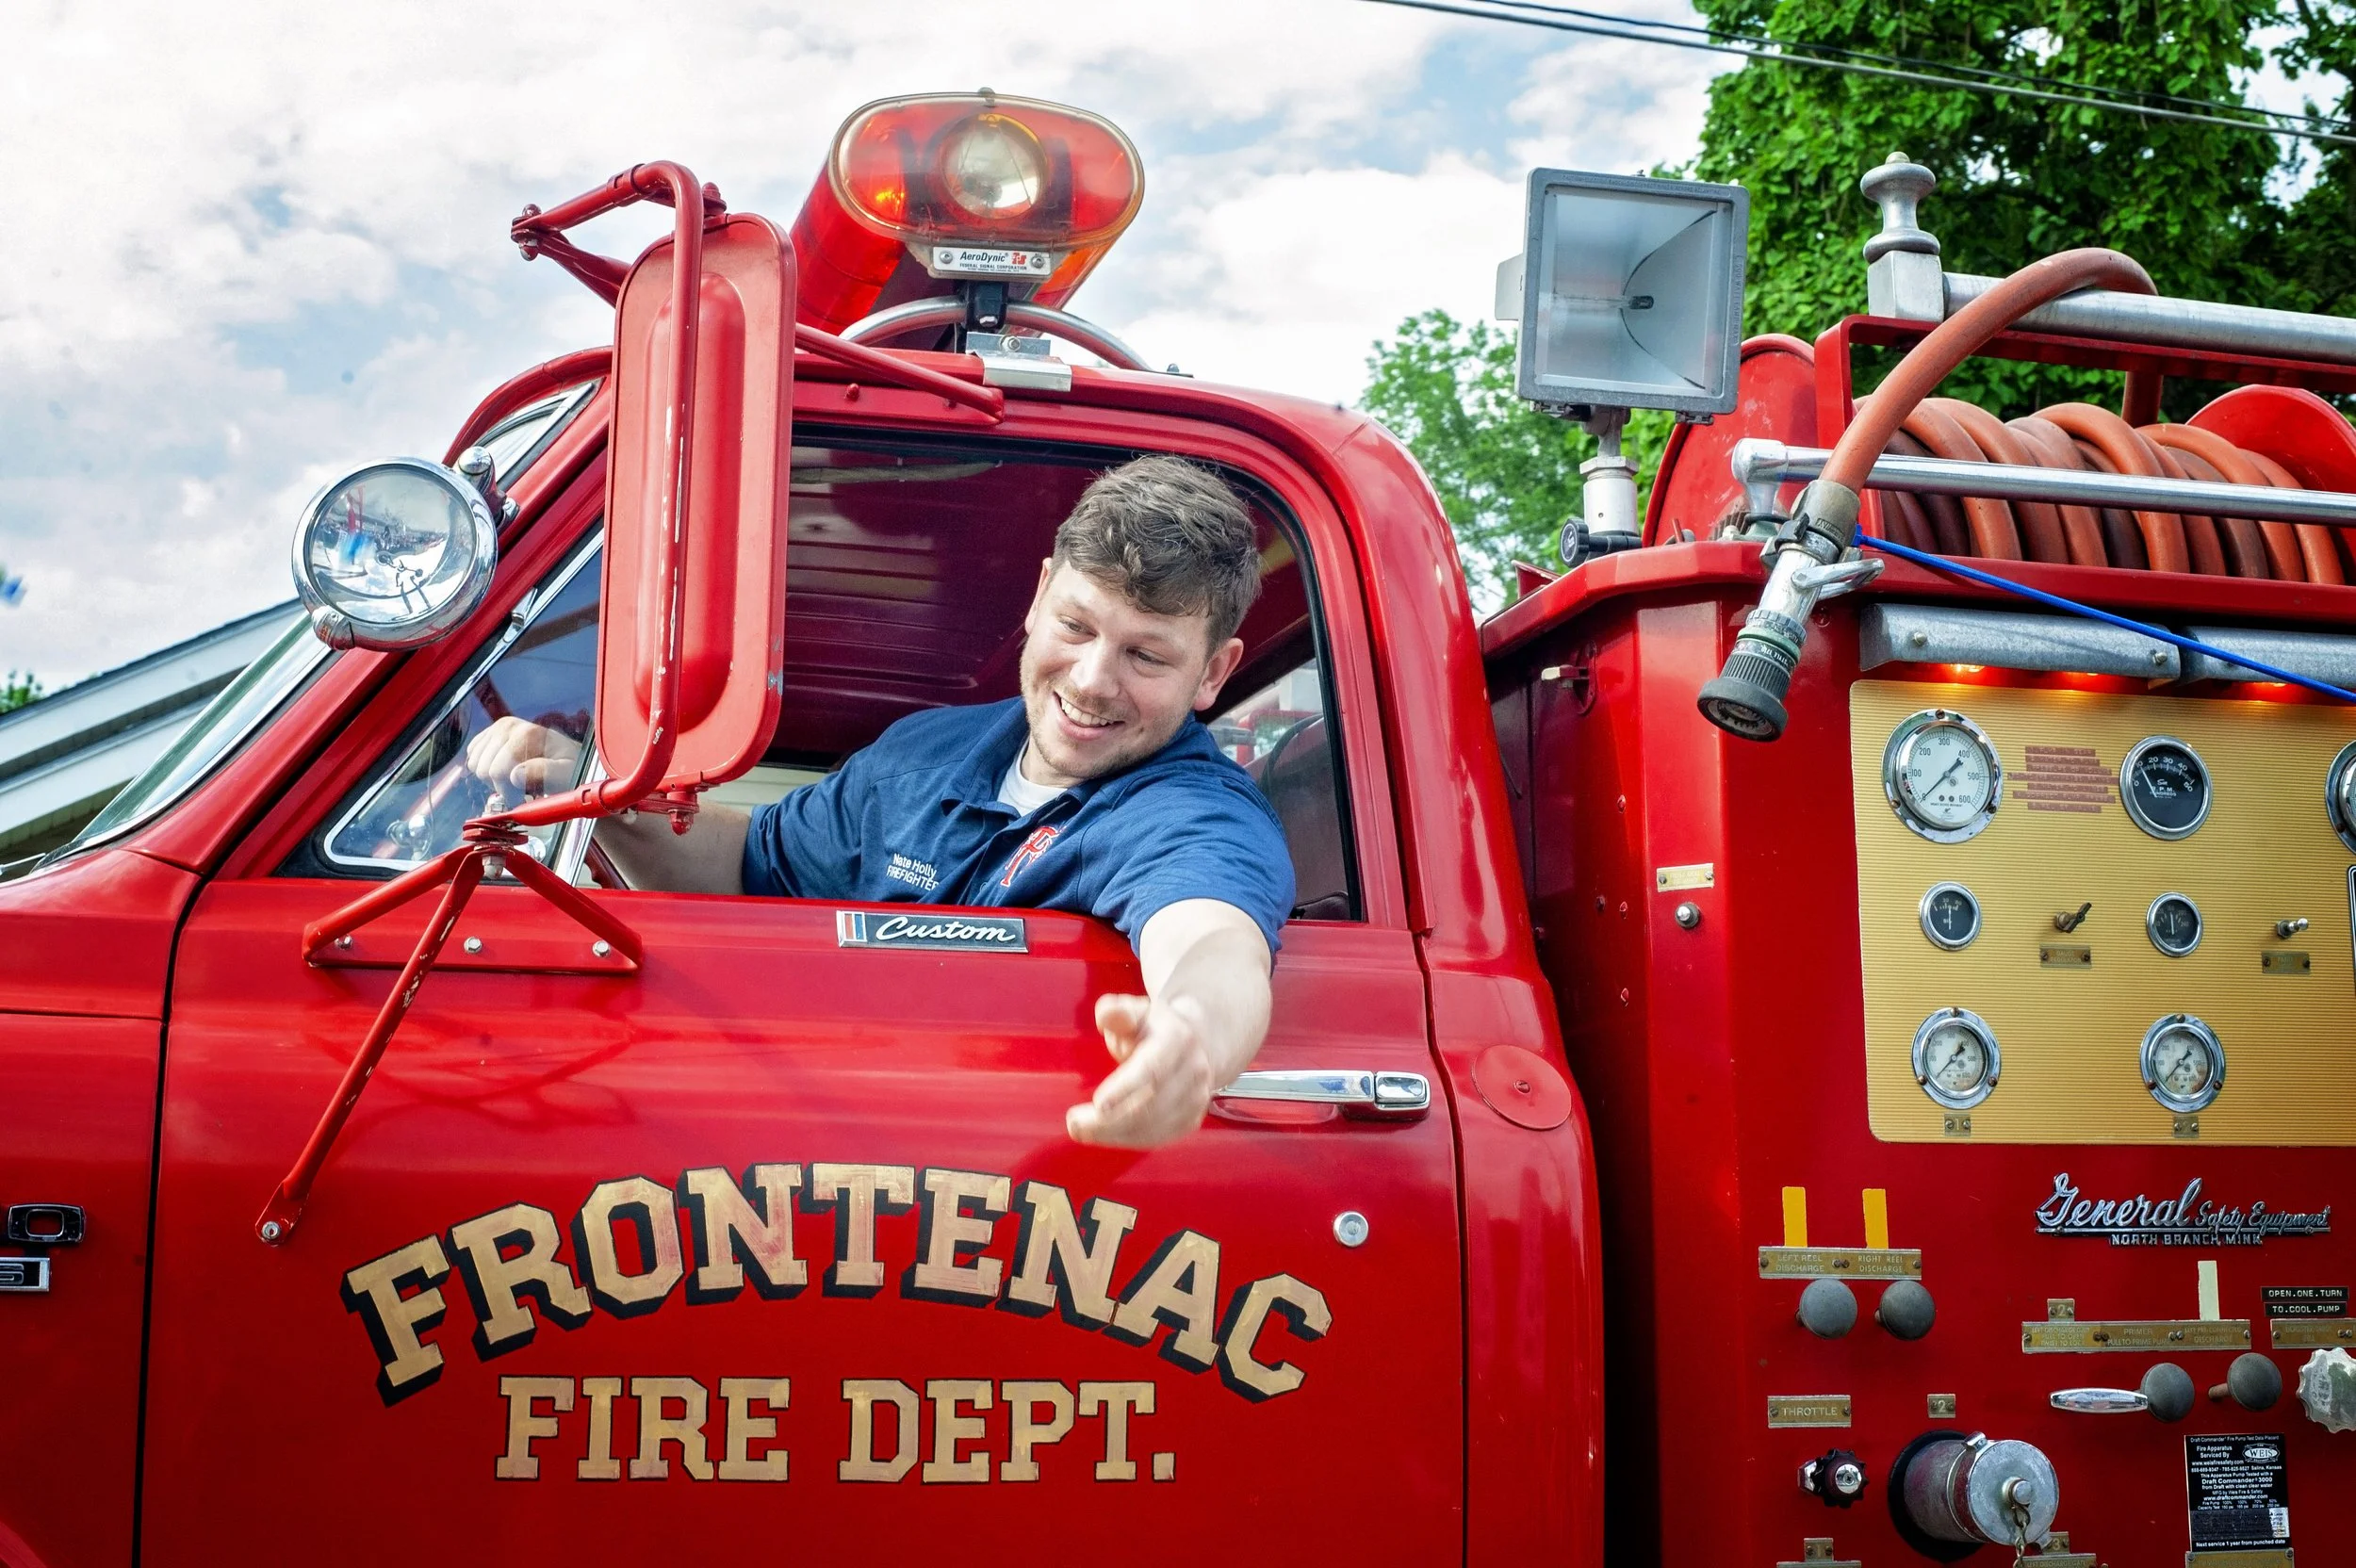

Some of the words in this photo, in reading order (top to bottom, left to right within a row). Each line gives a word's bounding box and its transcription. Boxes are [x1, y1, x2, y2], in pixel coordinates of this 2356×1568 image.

[1938, 738, 1950, 746] 300
[1919, 748, 1931, 756] 200
[1958, 750, 1970, 758] 400
[1967, 773, 1979, 781] 500
[893, 853, 912, 868] Nate
[912, 859, 937, 880] Holly
[875, 917, 1015, 941] Custom
[2034, 1172, 2202, 1227] General
[2195, 1200, 2246, 1234] Safety
[2248, 1200, 2331, 1235] Equipment
[2110, 1234, 2158, 1245] NORTH
[1776, 1264, 1825, 1272] DISCHARGE
[340, 1162, 1333, 1408] FRONTENAC
[2058, 1304, 2066, 1316] 2
[1782, 1406, 1838, 1416] THROTTLE
[1938, 1400, 1946, 1412] 2
[495, 1375, 790, 1482] FIRE
[837, 1377, 1177, 1484] DEPT.
[2053, 1538, 2060, 1550] 3
